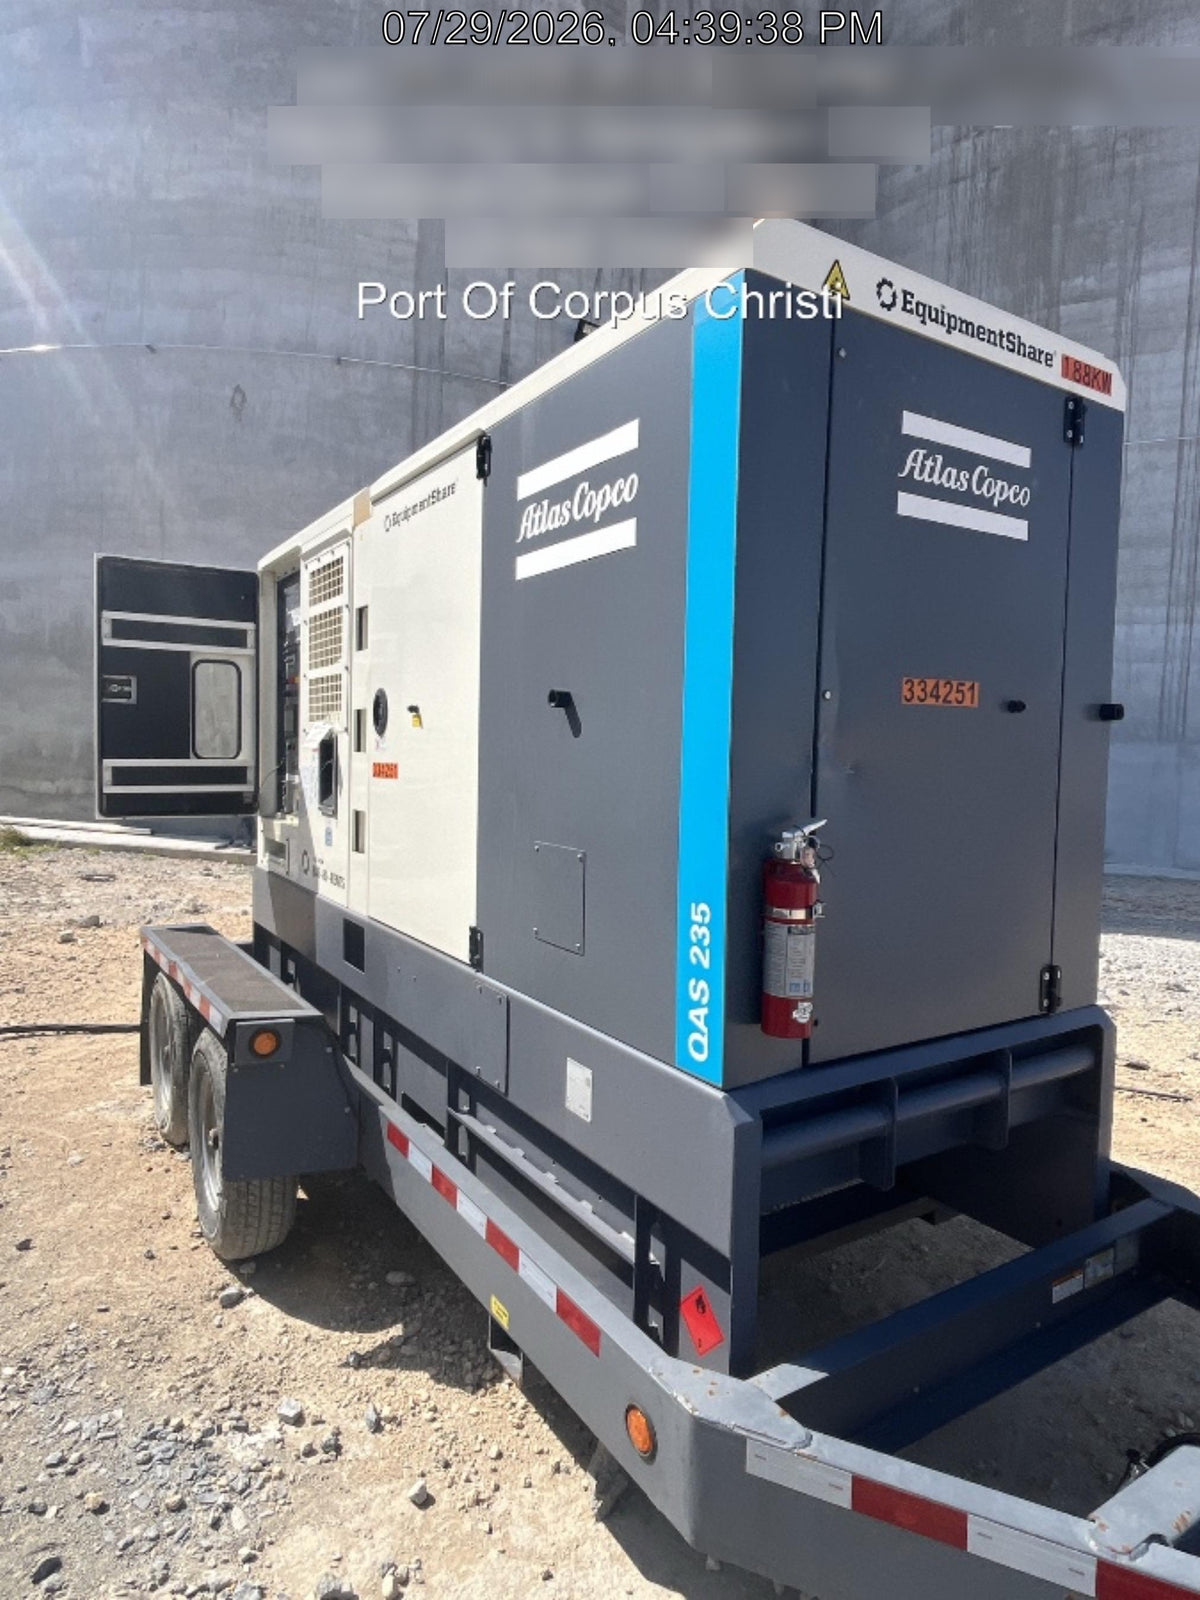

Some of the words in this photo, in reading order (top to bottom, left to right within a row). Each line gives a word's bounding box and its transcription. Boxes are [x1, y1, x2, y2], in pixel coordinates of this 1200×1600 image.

[901, 289, 1054, 368] EquipmentShare
[1063, 356, 1112, 396] 188KW
[515, 499, 571, 543] Atlas
[572, 473, 640, 523] Copco
[898, 448, 969, 492] Atlas
[971, 465, 1031, 507] Copco
[903, 679, 976, 705] 334251
[690, 902, 712, 970] 235
[688, 978, 711, 1063] QAS
